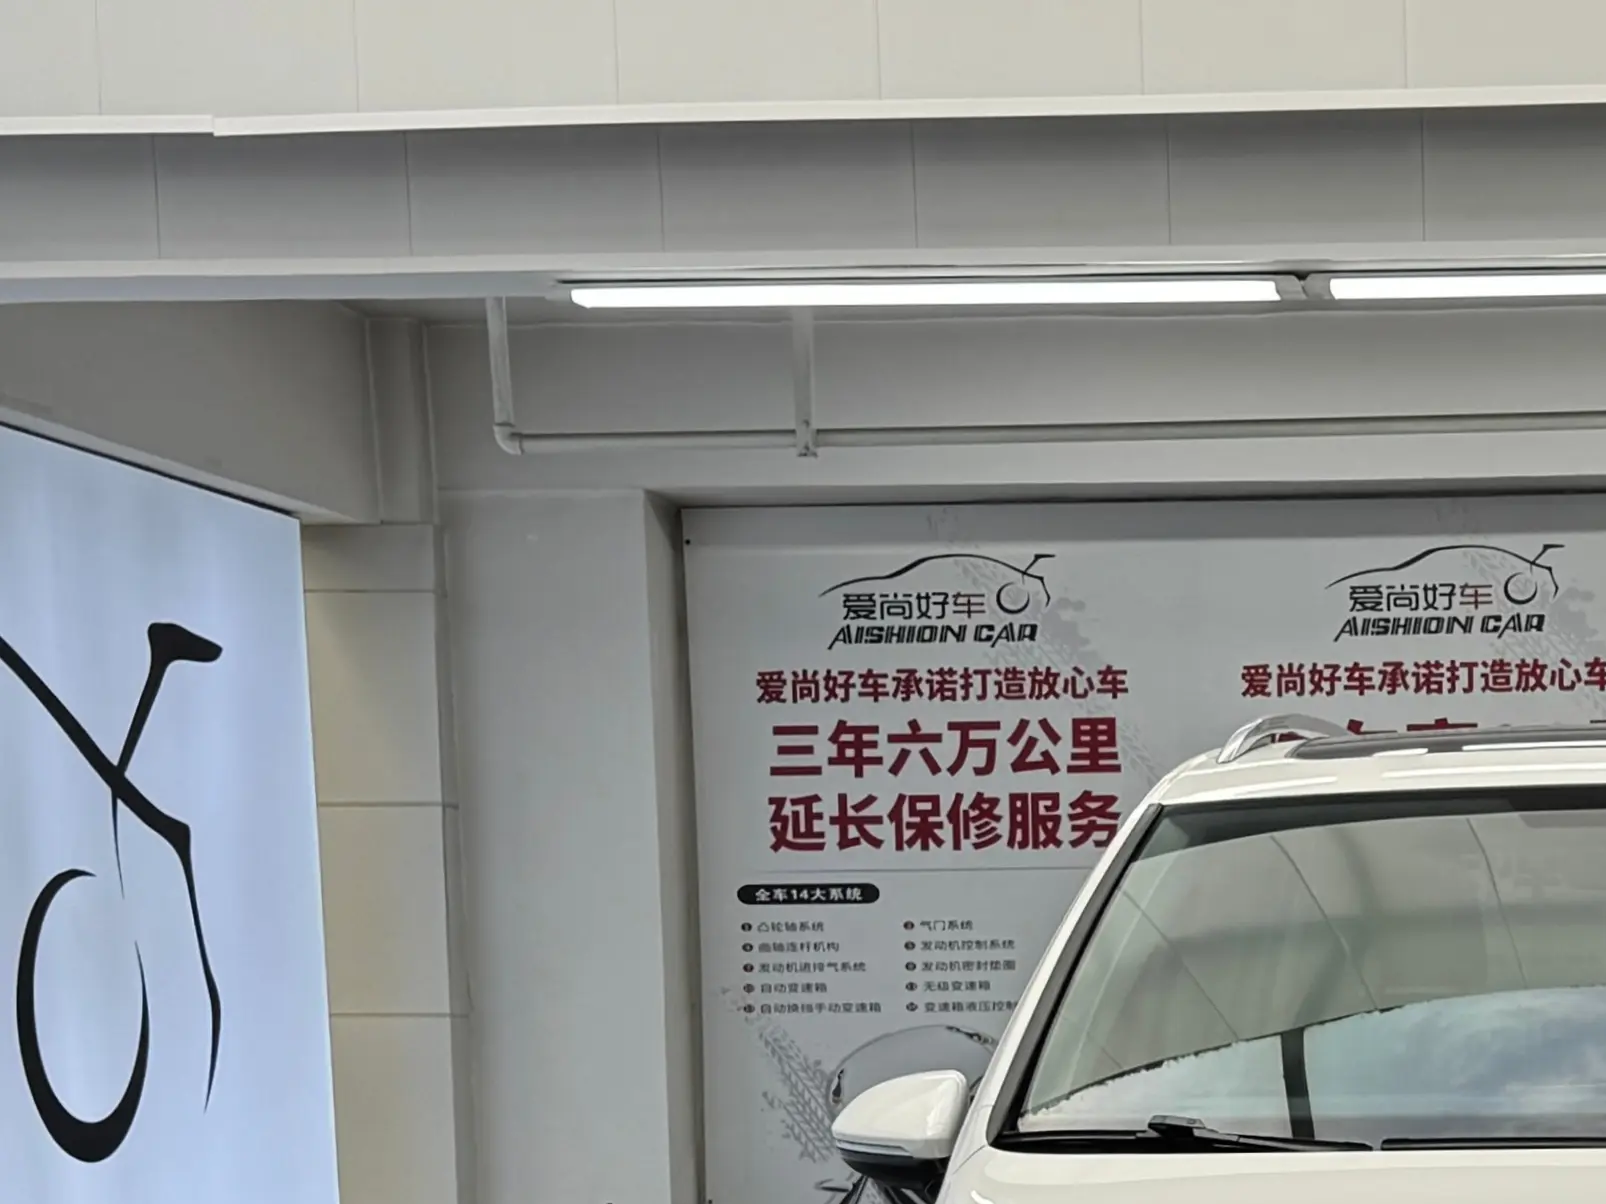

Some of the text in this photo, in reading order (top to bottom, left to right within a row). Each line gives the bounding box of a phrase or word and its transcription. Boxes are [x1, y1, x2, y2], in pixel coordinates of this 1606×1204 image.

[842, 591, 986, 620] 爱尚好车
[1349, 583, 1494, 612] 爱尚好车
[827, 622, 1039, 650] AISHION CAR
[1333, 614, 1546, 642] AISHION CAR
[755, 665, 1129, 704] 爱尚好车承诺打造放心车
[769, 716, 1123, 779] 三年六万公里
[767, 789, 1122, 854] 延长保修服务
[755, 886, 864, 902] 全车14大系统
